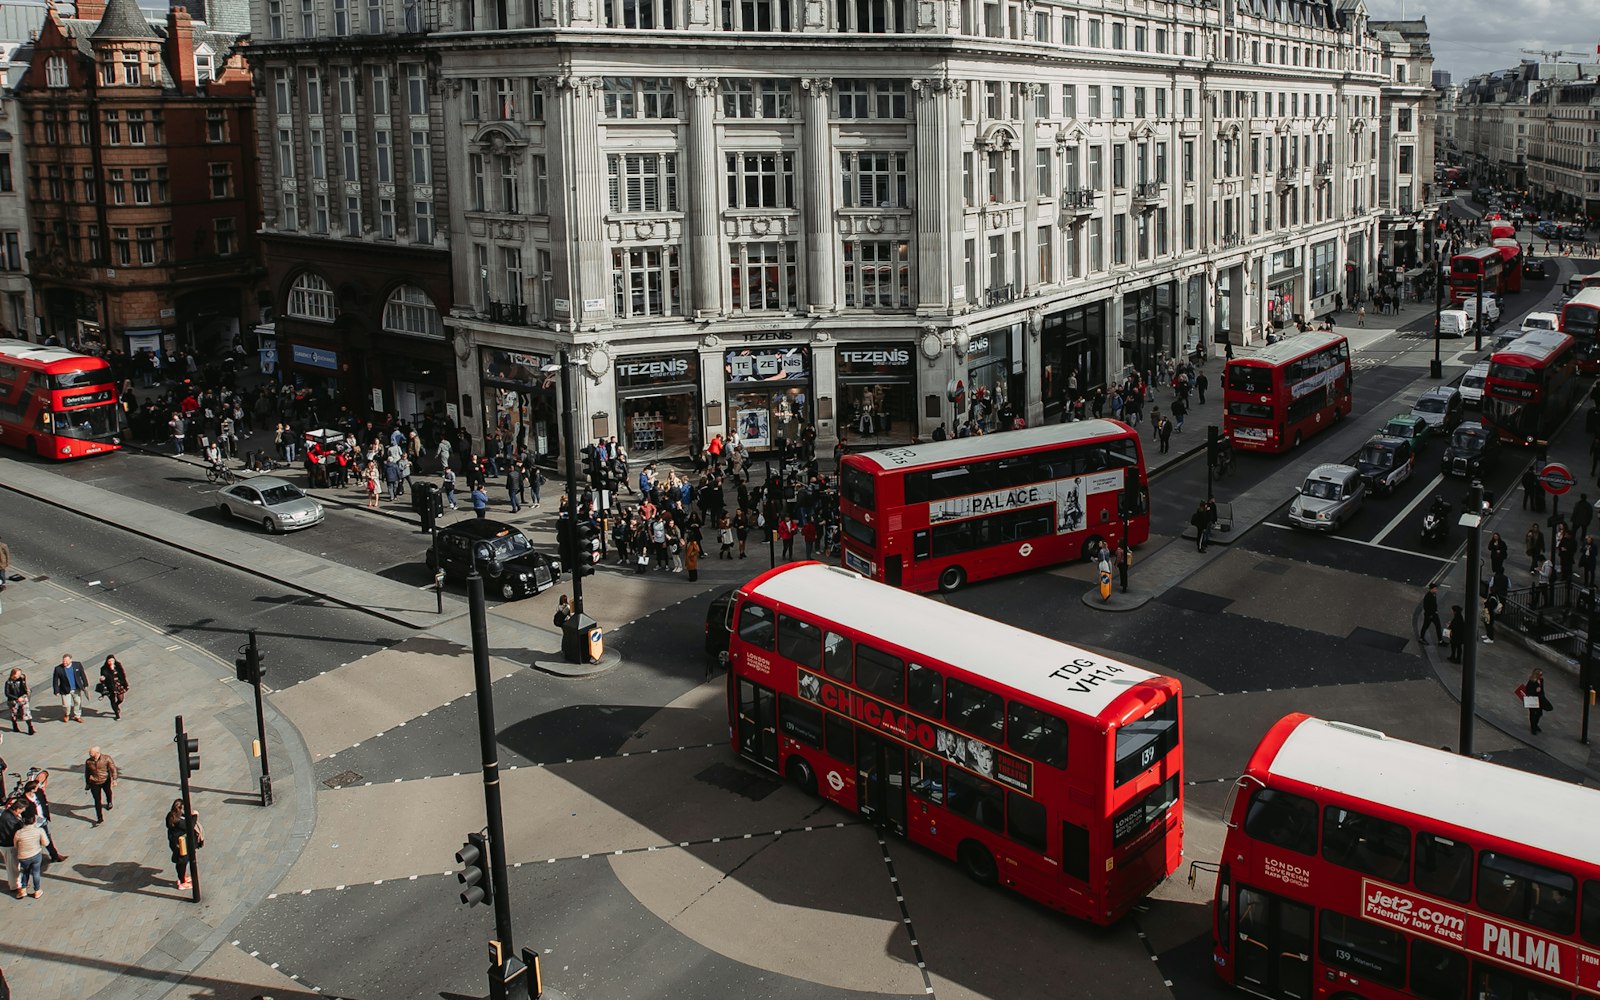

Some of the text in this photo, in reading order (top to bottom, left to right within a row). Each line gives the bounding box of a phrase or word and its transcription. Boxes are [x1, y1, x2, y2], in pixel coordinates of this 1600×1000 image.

[742, 331, 793, 341] TEZENIS
[967, 336, 988, 353] ENIS
[735, 361, 750, 370] TE
[760, 360, 775, 368] ZE
[841, 348, 910, 363] TEZENIS
[616, 358, 689, 376] TEZENIS
[1245, 383, 1255, 392] 25
[972, 487, 1039, 513] PALACE
[746, 651, 770, 666] LONDON
[1048, 659, 1096, 680] TDG
[1067, 665, 1125, 693] VH14
[821, 682, 937, 750] CHICAGO
[1141, 745, 1155, 767] 139
[1115, 807, 1143, 829] LONDON
[1264, 857, 1310, 877] LONDON
[1264, 864, 1310, 883] SOVEREIGN
[1367, 890, 1464, 932] Jet2.com
[1366, 903, 1463, 941] Friendly low fares
[1336, 949, 1351, 961] 139
[1482, 922, 1599, 975] PALMA FROM
